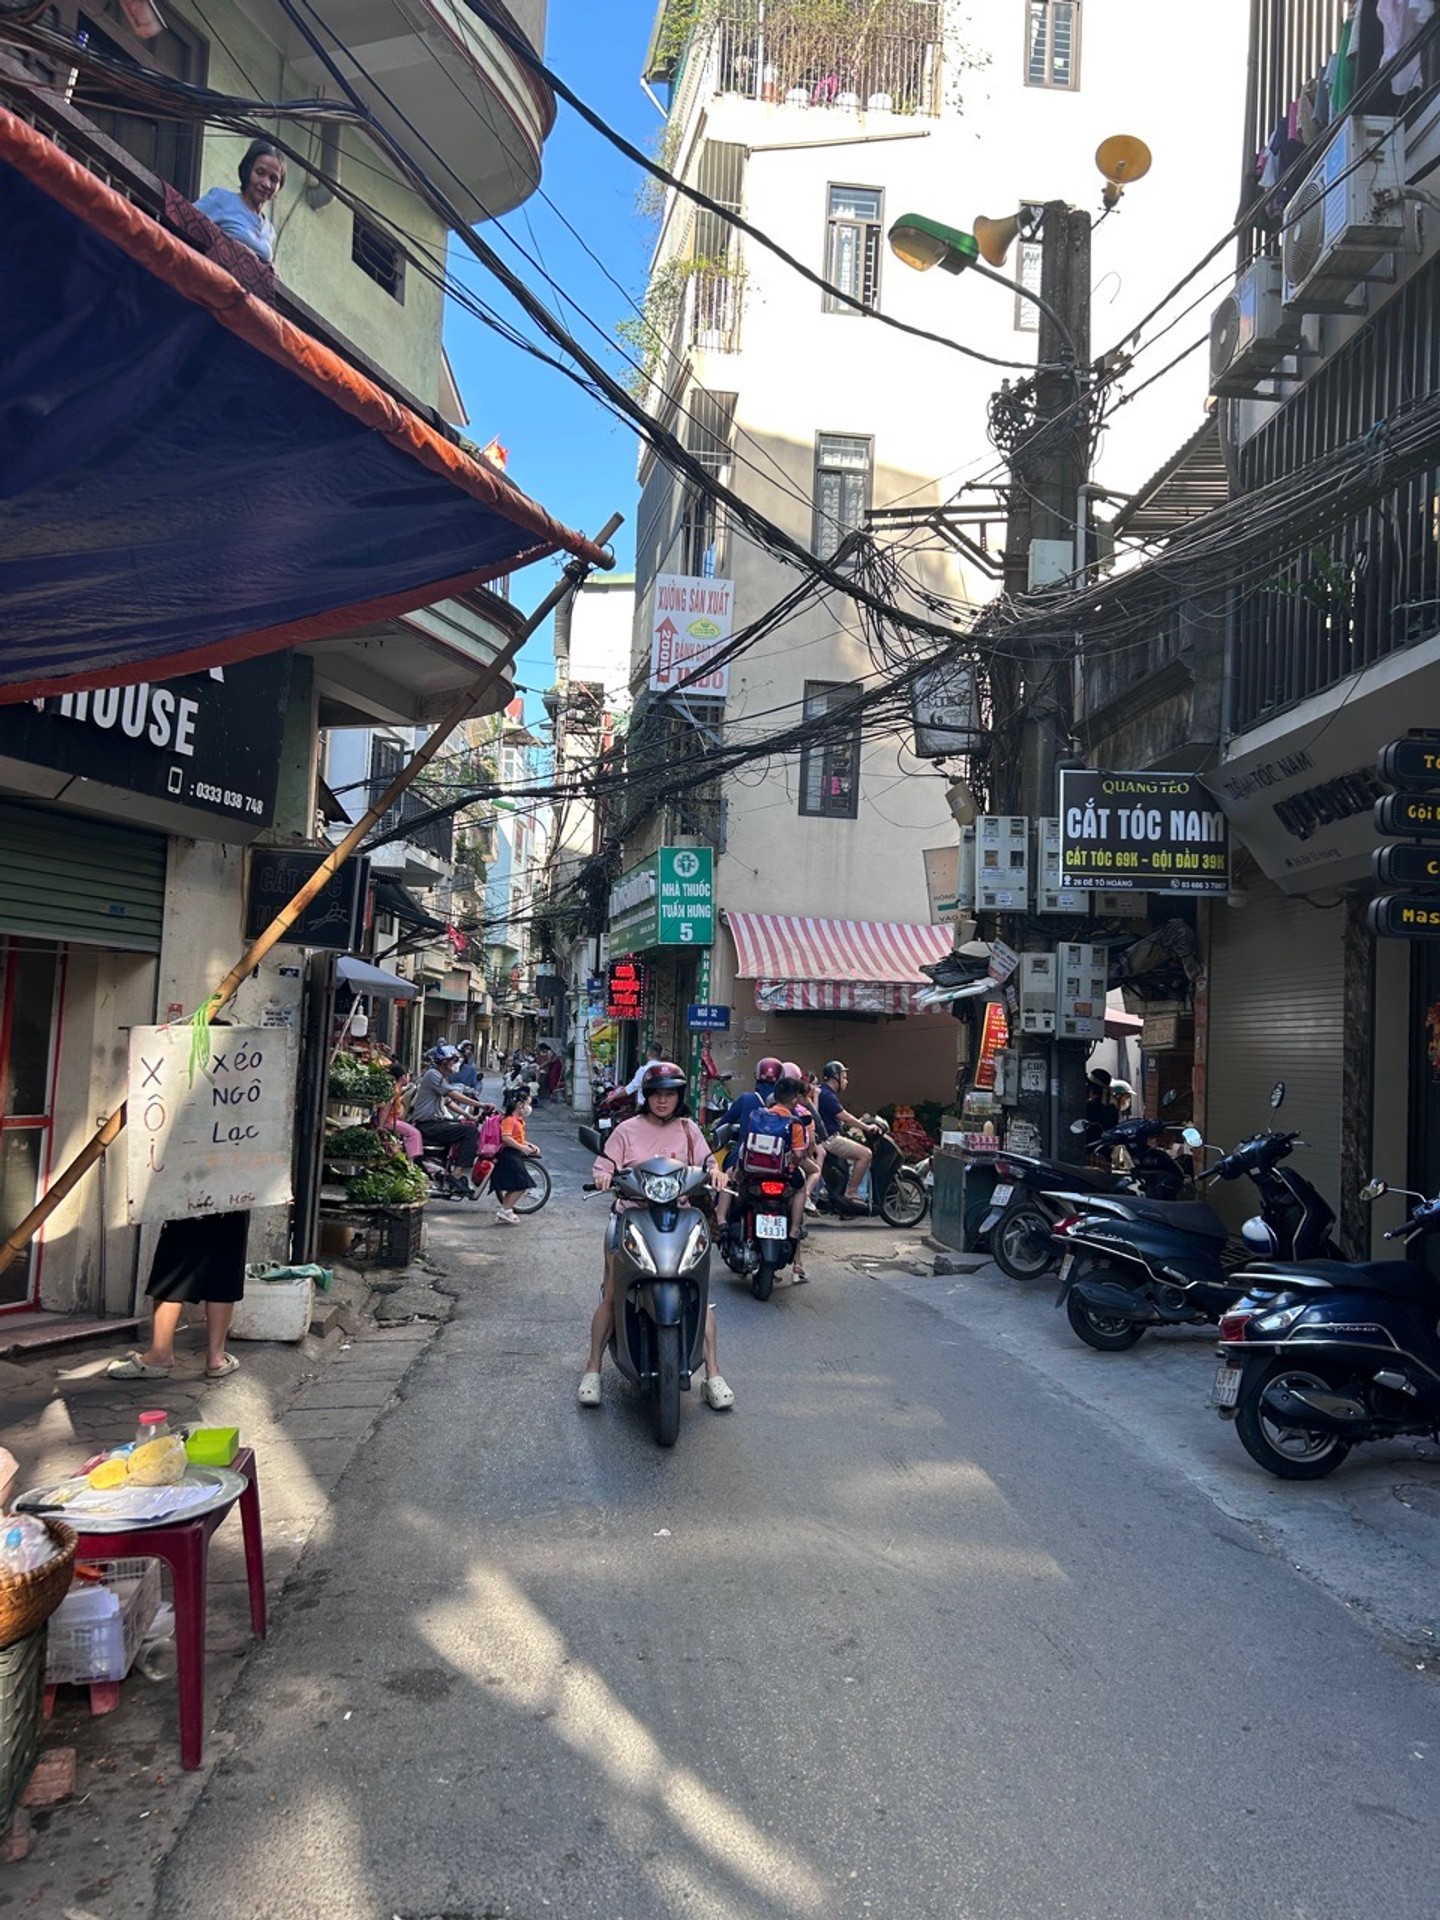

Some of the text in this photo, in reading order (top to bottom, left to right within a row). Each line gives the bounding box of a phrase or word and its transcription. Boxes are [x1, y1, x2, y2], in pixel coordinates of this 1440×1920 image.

[196, 781, 222, 803] 0333
[223, 790, 243, 808] 038
[245, 797, 264, 815] 748
[1066, 797, 1224, 842] CẮT TÓC NAM
[1091, 848, 1113, 867] TÓC
[1116, 851, 1139, 868] 69K
[1152, 849, 1172, 871] GỘI
[1175, 847, 1199, 869] ĐẦU
[1202, 853, 1226, 870] 39K
[662, 879, 711, 897] NHÀ THUỐC
[662, 900, 685, 918] TUẤN
[680, 922, 693, 942] 5
[212, 1078, 261, 1107] NGÔ
[212, 1121, 260, 1146] Lạc
